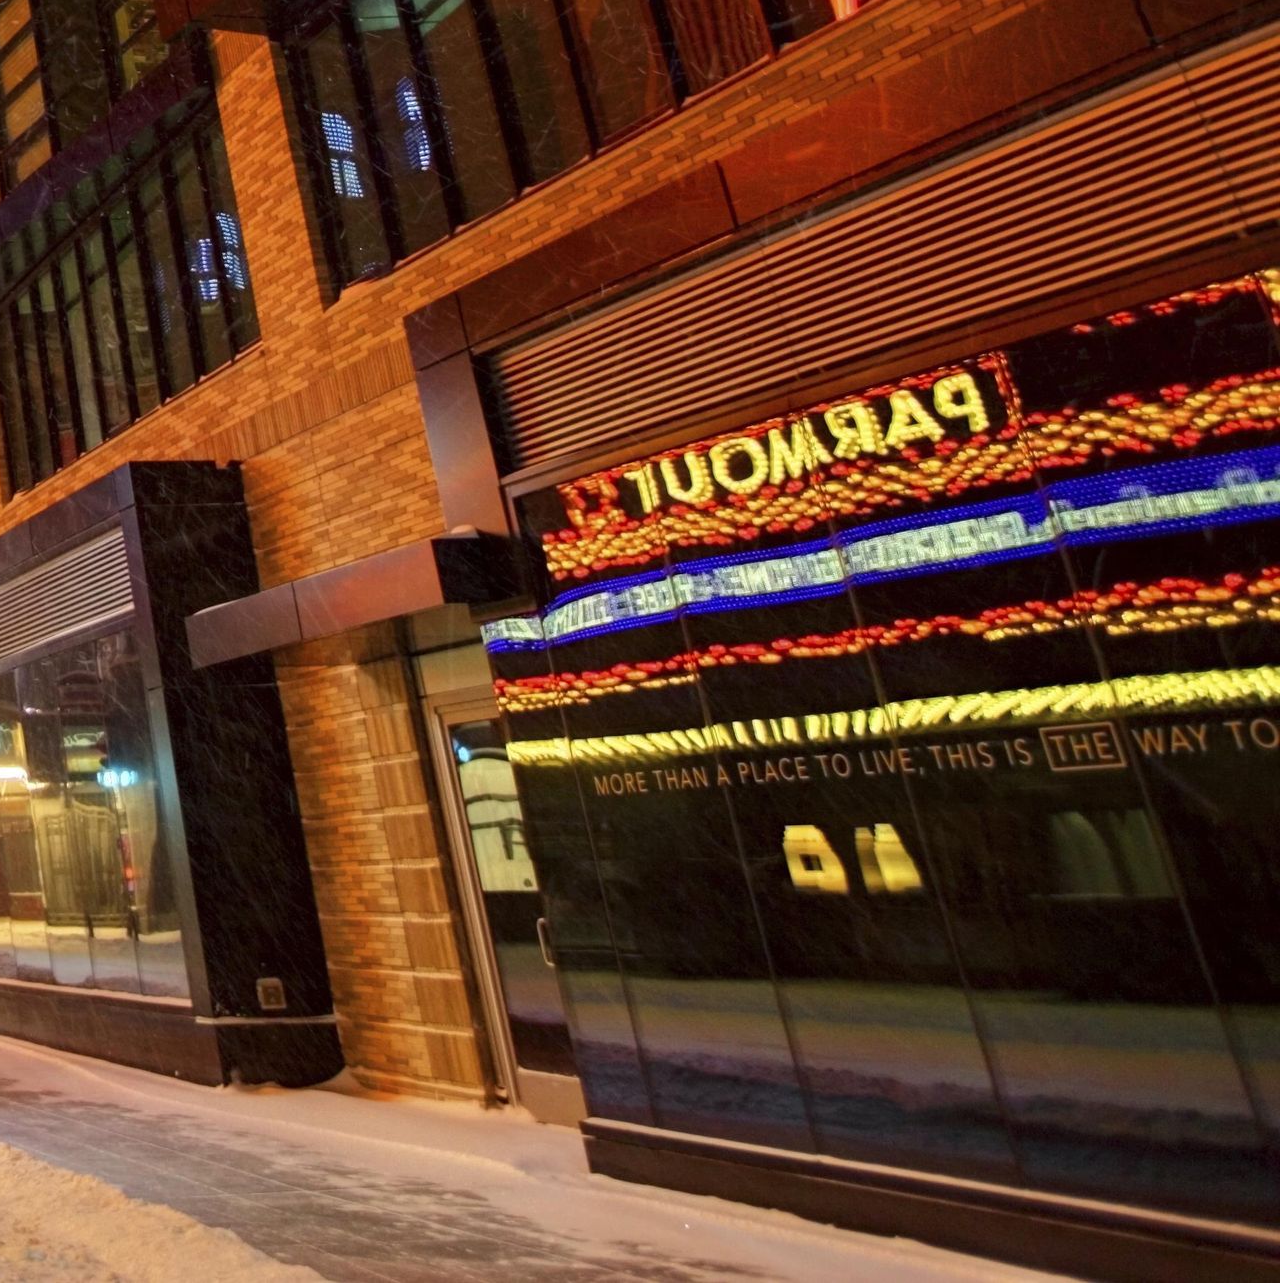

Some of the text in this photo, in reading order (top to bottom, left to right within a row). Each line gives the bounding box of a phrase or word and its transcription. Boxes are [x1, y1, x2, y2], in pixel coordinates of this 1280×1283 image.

[593, 771, 649, 797] MORE
[651, 764, 710, 792] THAN
[716, 763, 732, 787] A
[737, 756, 811, 785] PLACE
[815, 752, 852, 778] TO
[927, 741, 996, 770] THIS
[1002, 737, 1034, 766] IS
[1048, 730, 1116, 762] THE
[1131, 723, 1208, 756] WAY
[1223, 717, 1279, 751] TO
